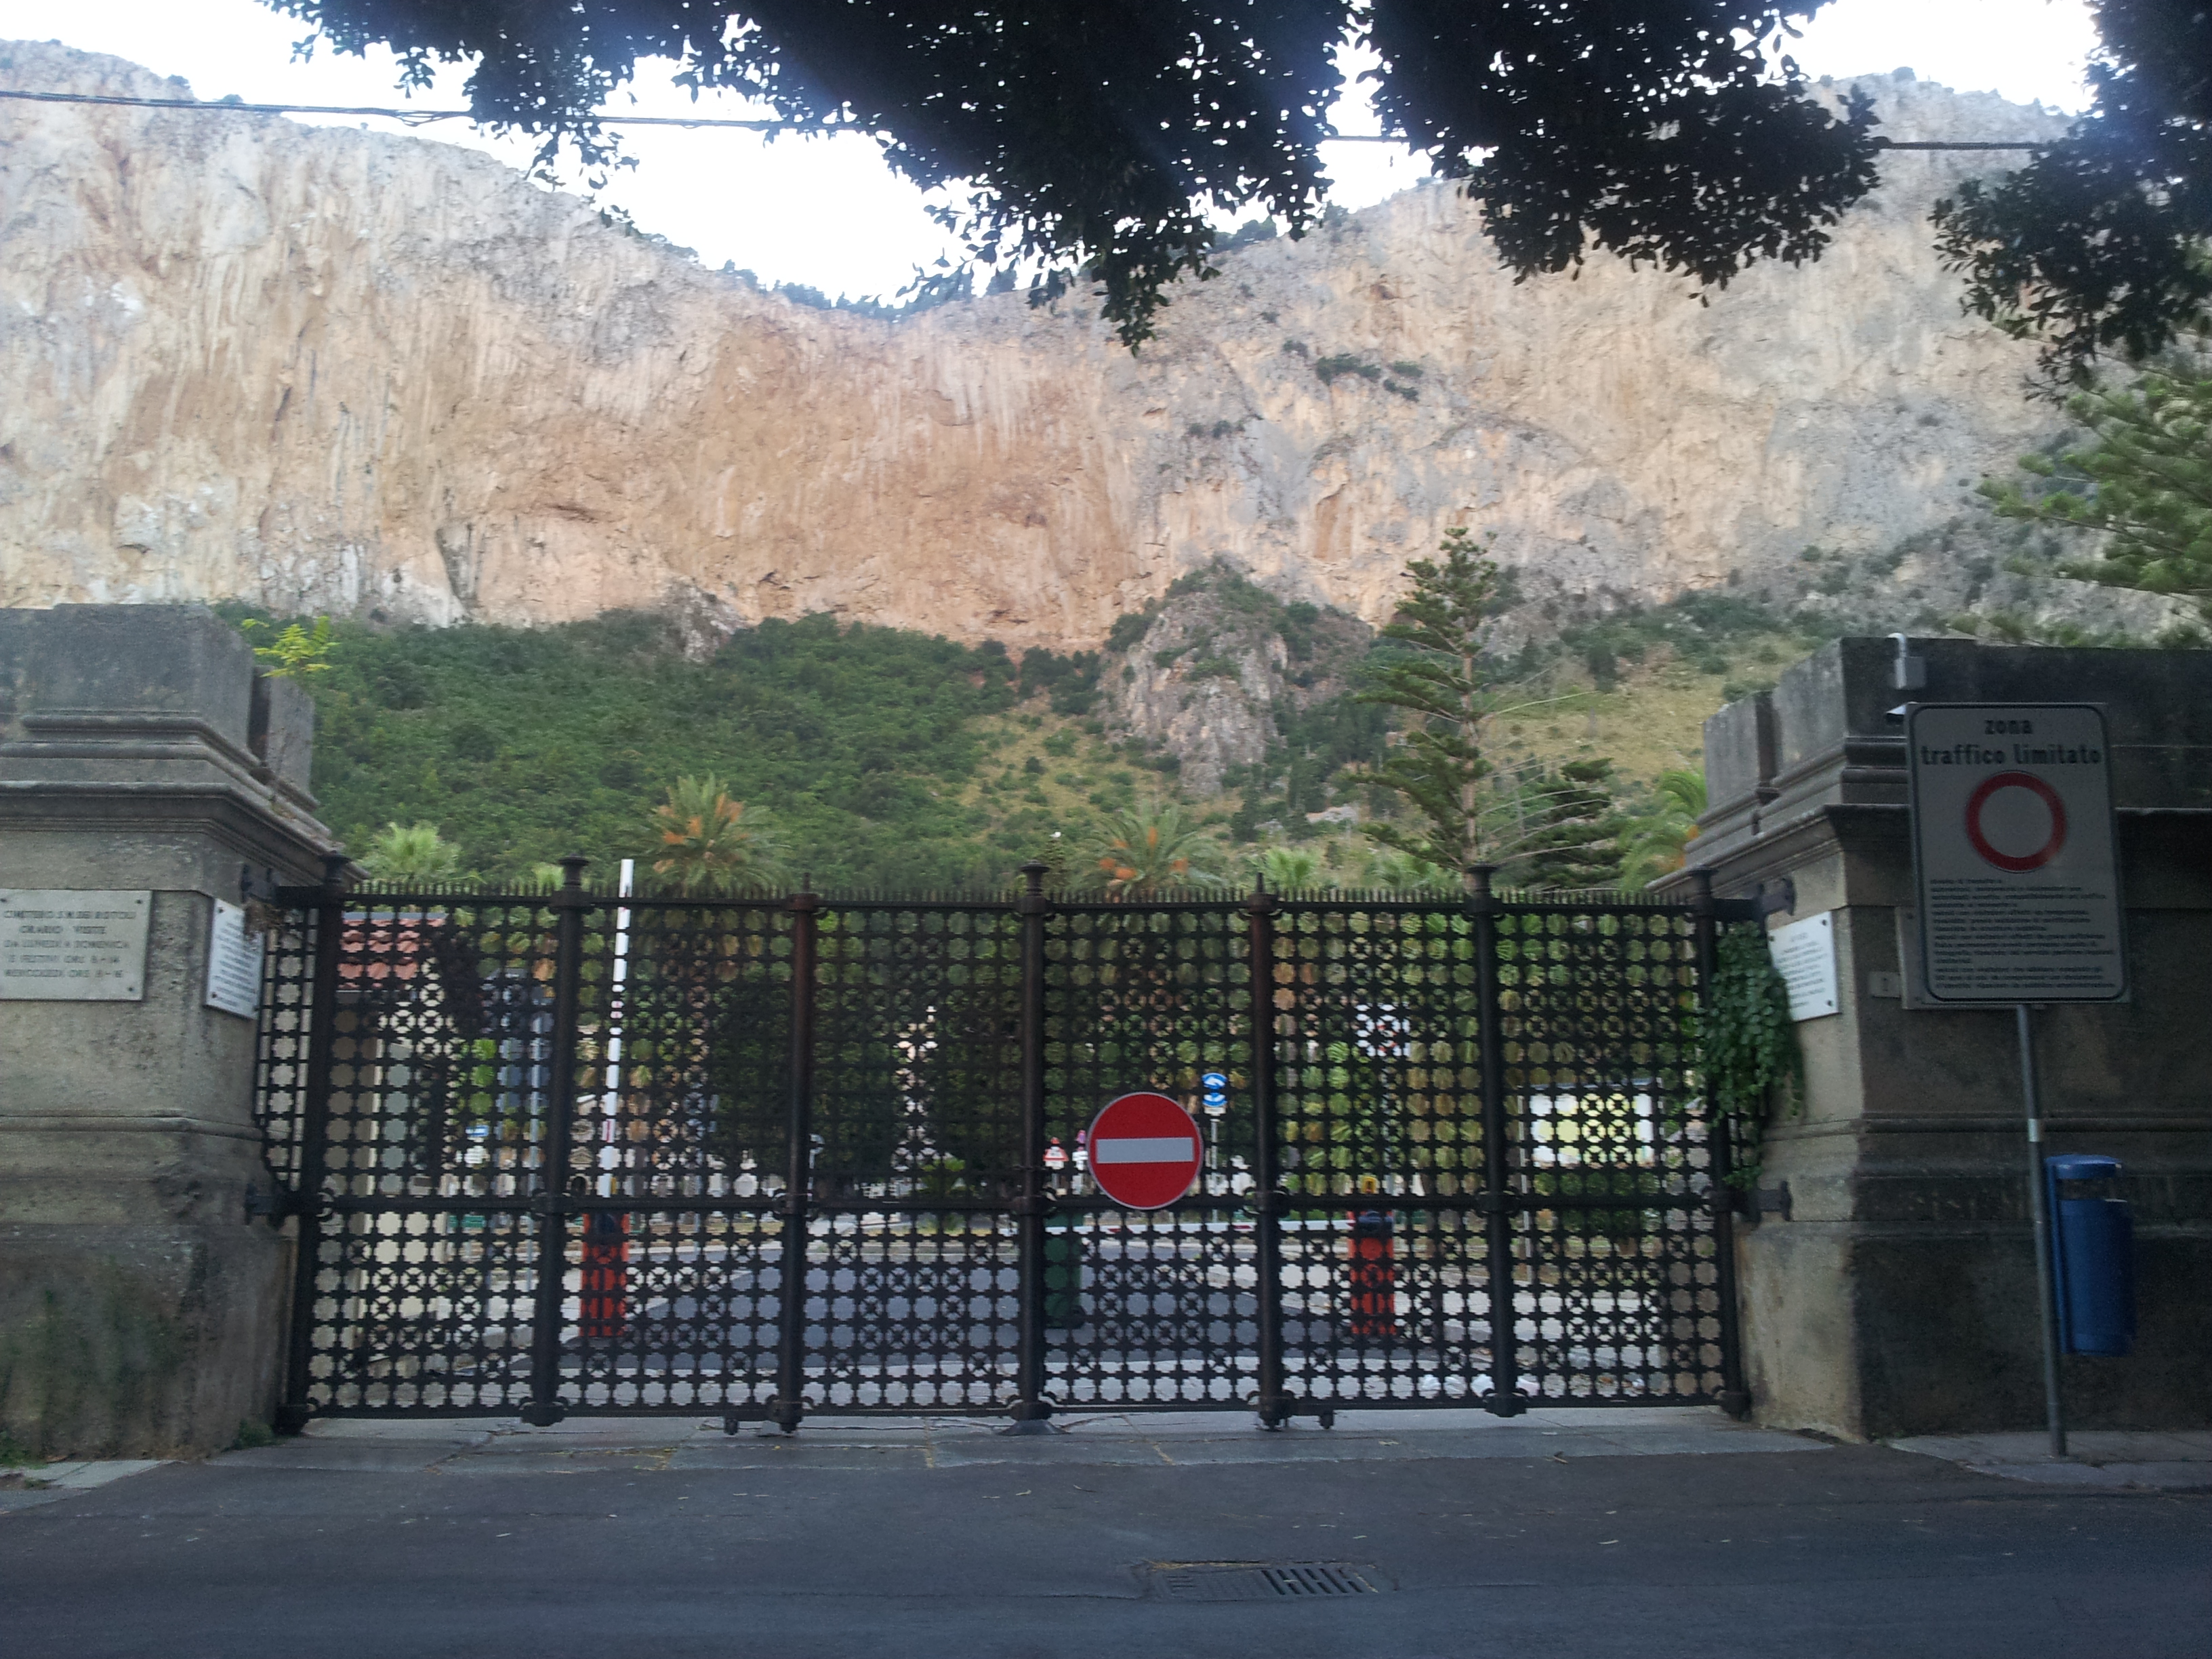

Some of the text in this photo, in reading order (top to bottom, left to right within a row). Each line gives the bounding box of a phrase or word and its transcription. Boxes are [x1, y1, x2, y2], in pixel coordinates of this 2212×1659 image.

[1984, 720, 2033, 735] zona
[1921, 743, 2101, 764] traffico limitato
[19, 925, 63, 934] ORARIO
